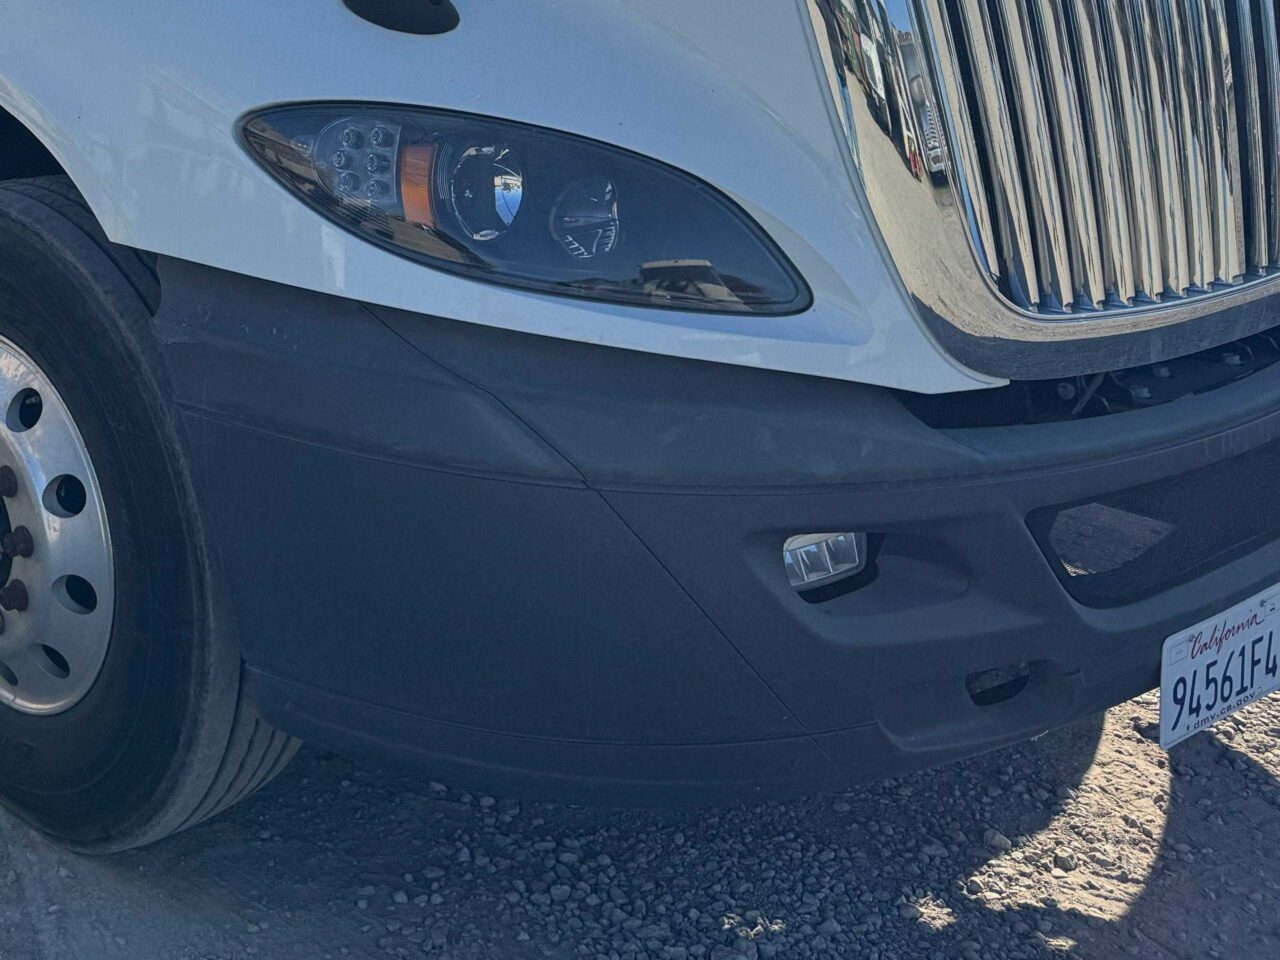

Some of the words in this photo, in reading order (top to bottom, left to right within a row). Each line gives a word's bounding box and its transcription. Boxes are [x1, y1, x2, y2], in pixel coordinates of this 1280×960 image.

[1191, 609, 1265, 660] California
[1171, 630, 1278, 731] 94561F4
[1193, 691, 1256, 730] dmv.ca.gov
